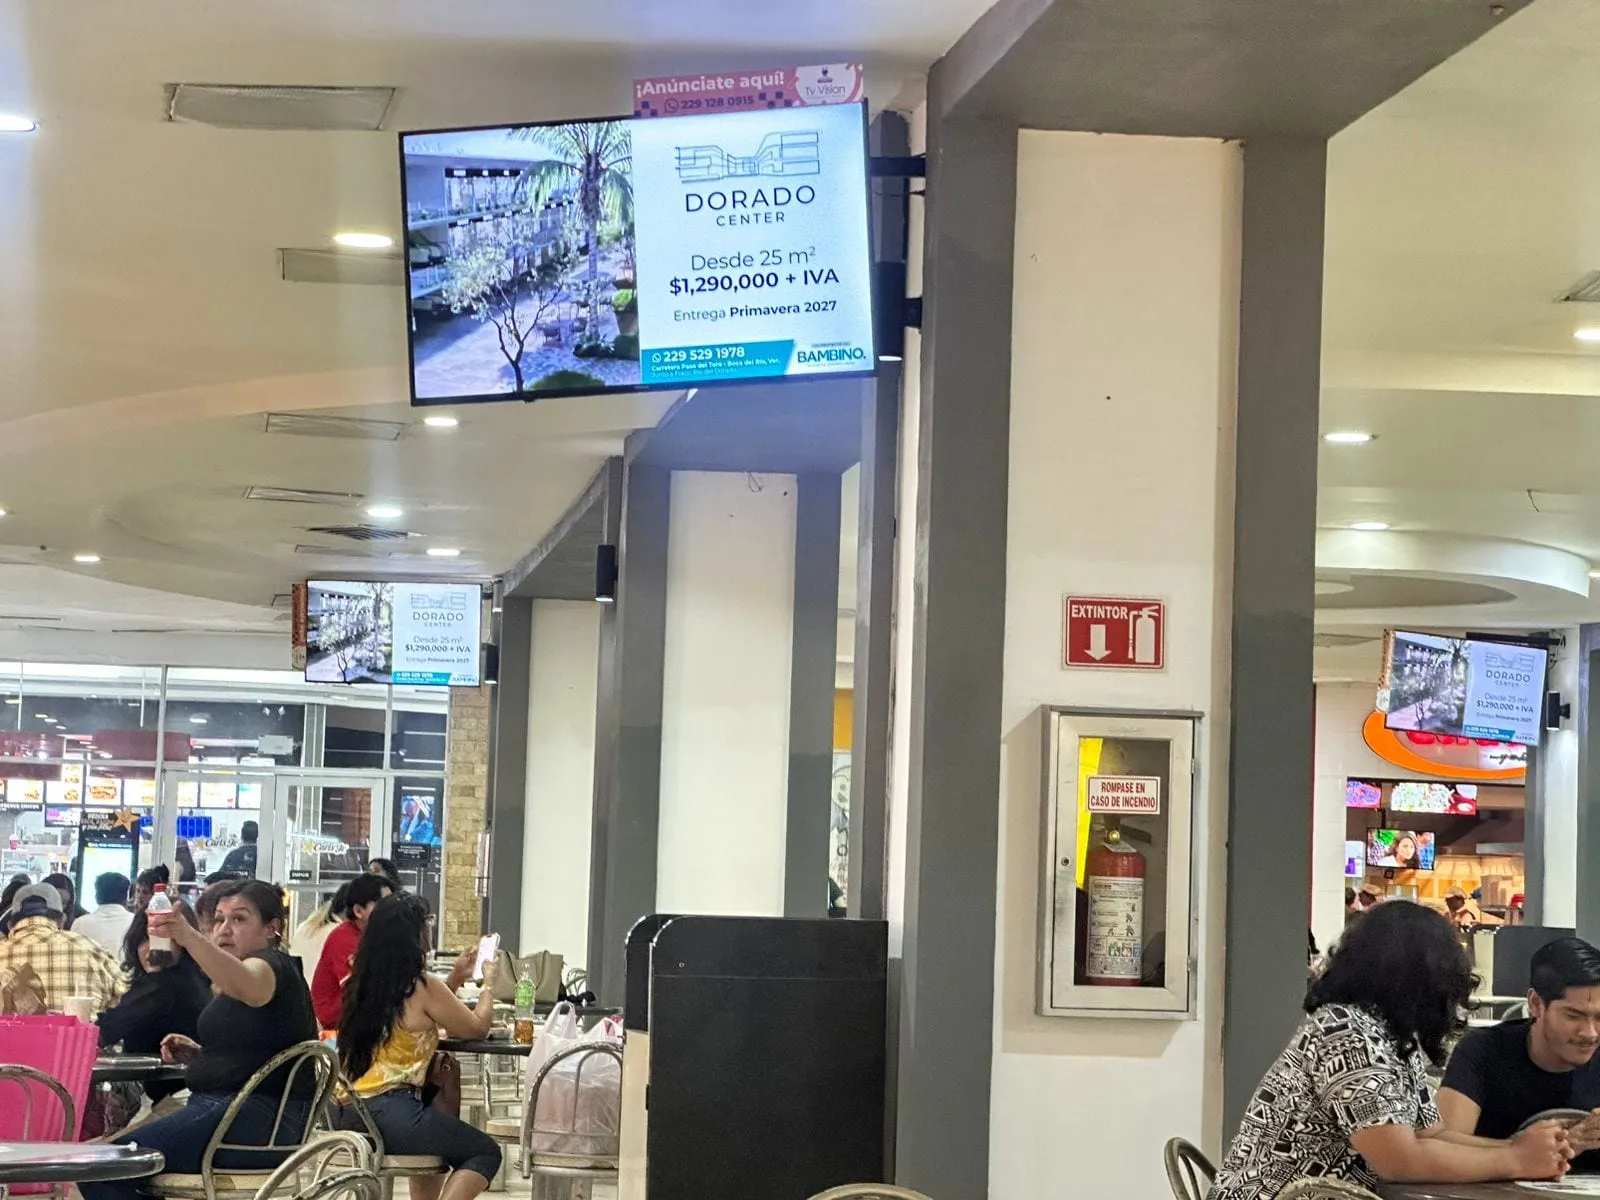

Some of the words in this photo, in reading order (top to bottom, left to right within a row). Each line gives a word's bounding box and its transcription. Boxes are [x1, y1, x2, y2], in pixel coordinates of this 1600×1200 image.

[636, 76, 733, 98] ¡Anúnciate
[740, 71, 784, 90] aquí!
[681, 100, 700, 110] 229
[705, 98, 724, 108] 128
[727, 96, 754, 106] 0915
[686, 185, 815, 212] DORADO
[716, 212, 785, 226] CENTER
[691, 252, 754, 271] Desde
[759, 249, 782, 266] 25
[669, 272, 778, 296] $1,290,000
[786, 273, 796, 284] +
[803, 268, 839, 285] IVA
[674, 308, 726, 322] Entrega
[729, 304, 800, 318] Primavera
[804, 300, 837, 313] 2027
[663, 350, 686, 362] 229
[690, 348, 713, 361] 529
[715, 346, 745, 359] 1978
[413, 611, 464, 621] DORADO
[1071, 605, 1128, 620] EXTINTOR
[405, 644, 448, 653] $1,290,000
[1486, 670, 1531, 682] DORADO
[1476, 700, 1514, 711] $1,290,000
[1521, 705, 1534, 713] IVA
[1102, 782, 1133, 793] ROMPASE
[1136, 783, 1146, 793] EN
[1091, 796, 1109, 807] CASO
[1111, 796, 1120, 807] DE
[1122, 797, 1155, 808] INCENDIO
